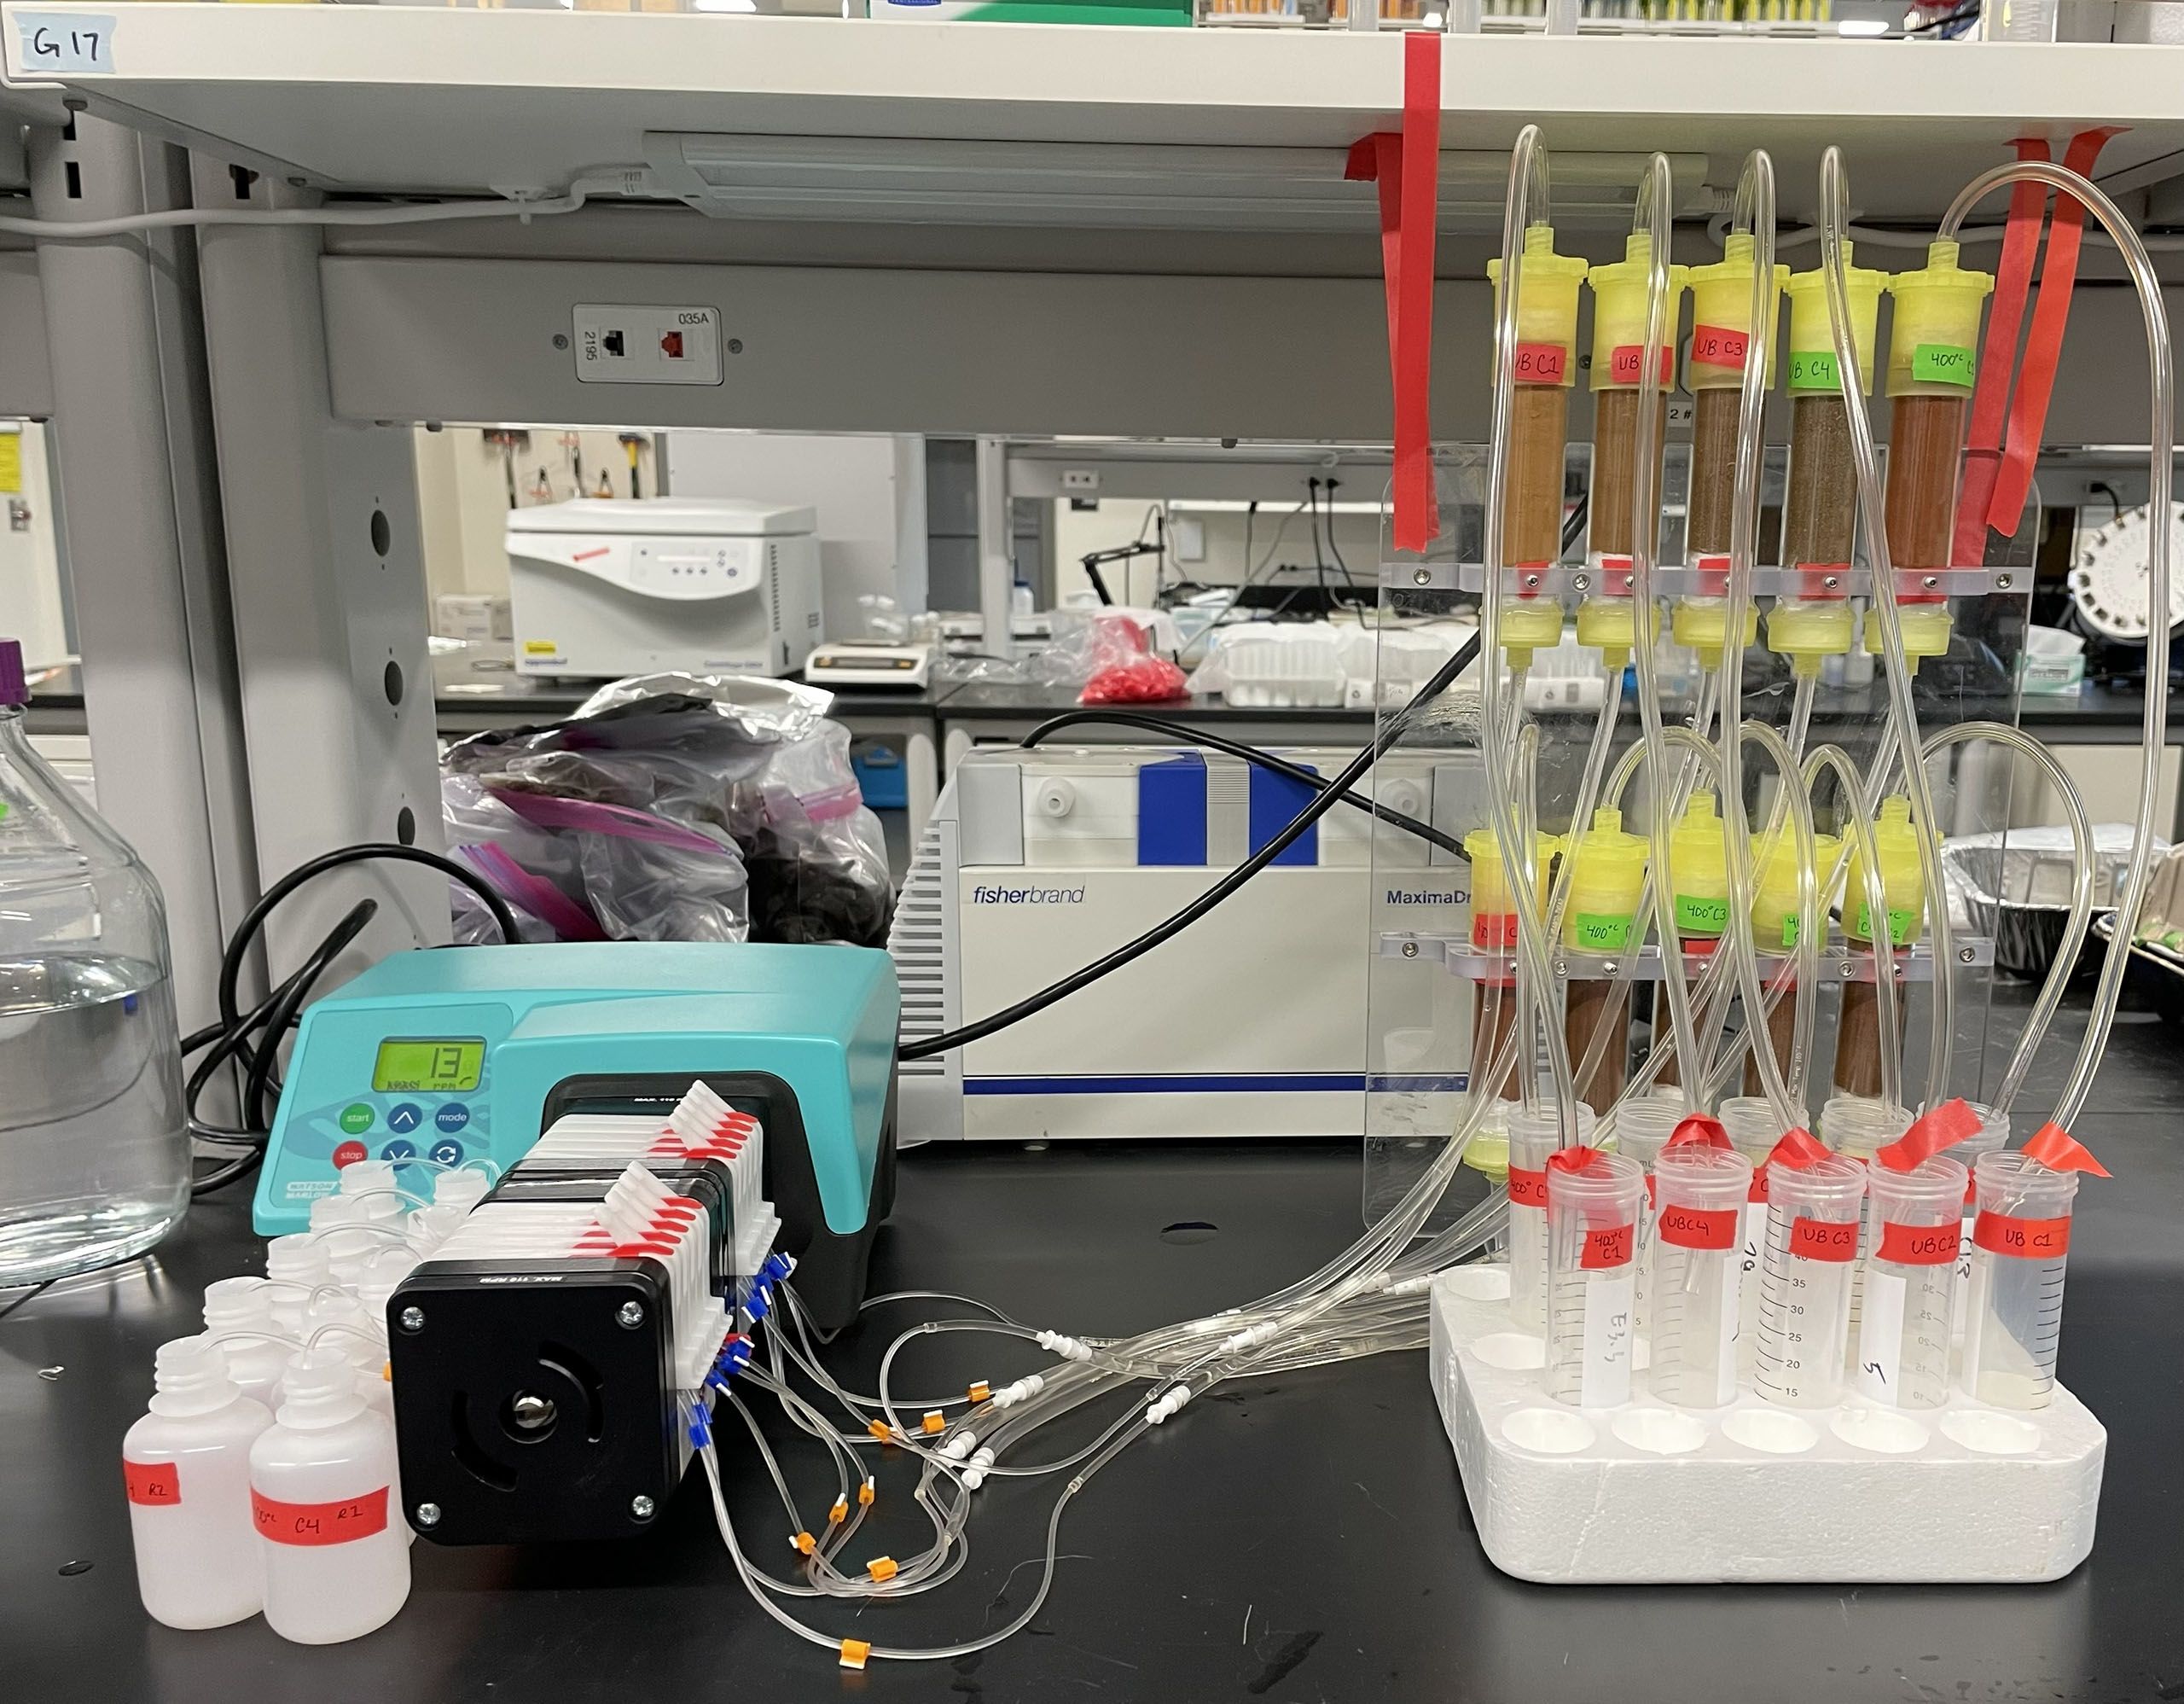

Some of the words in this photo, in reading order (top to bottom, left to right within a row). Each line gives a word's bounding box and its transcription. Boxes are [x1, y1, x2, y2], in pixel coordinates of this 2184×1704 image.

[678, 312, 710, 325] 035A
[584, 331, 597, 361] 2195
[1698, 339, 1717, 356] UB
[1724, 341, 1743, 356] C3
[1536, 354, 1560, 374] C1
[1619, 355, 1639, 370] UB
[1811, 361, 1830, 380] C4
[1670, 409, 1678, 419] 2
[973, 885, 1085, 904] fisherbrand
[1387, 890, 1471, 904] MaximaDr
[430, 1047, 462, 1079] 13
[346, 1114, 370, 1123] start
[438, 1113, 468, 1122] mode
[340, 1151, 363, 1161] stop
[1804, 1228, 1828, 1243] UB
[1833, 1231, 1850, 1245] C3
[2006, 1229, 2026, 1247] UB
[2033, 1234, 2053, 1247] C1
[1603, 1246, 1623, 1260] C1
[1792, 1278, 1806, 1288] 35
[1791, 1306, 1804, 1315] 30
[1788, 1333, 1802, 1342] 25
[1786, 1360, 1800, 1370] 20
[1786, 1388, 1798, 1398] 15
[148, 1482, 168, 1497] R2
[294, 1516, 320, 1534] C4
[336, 1505, 364, 1521] R1
